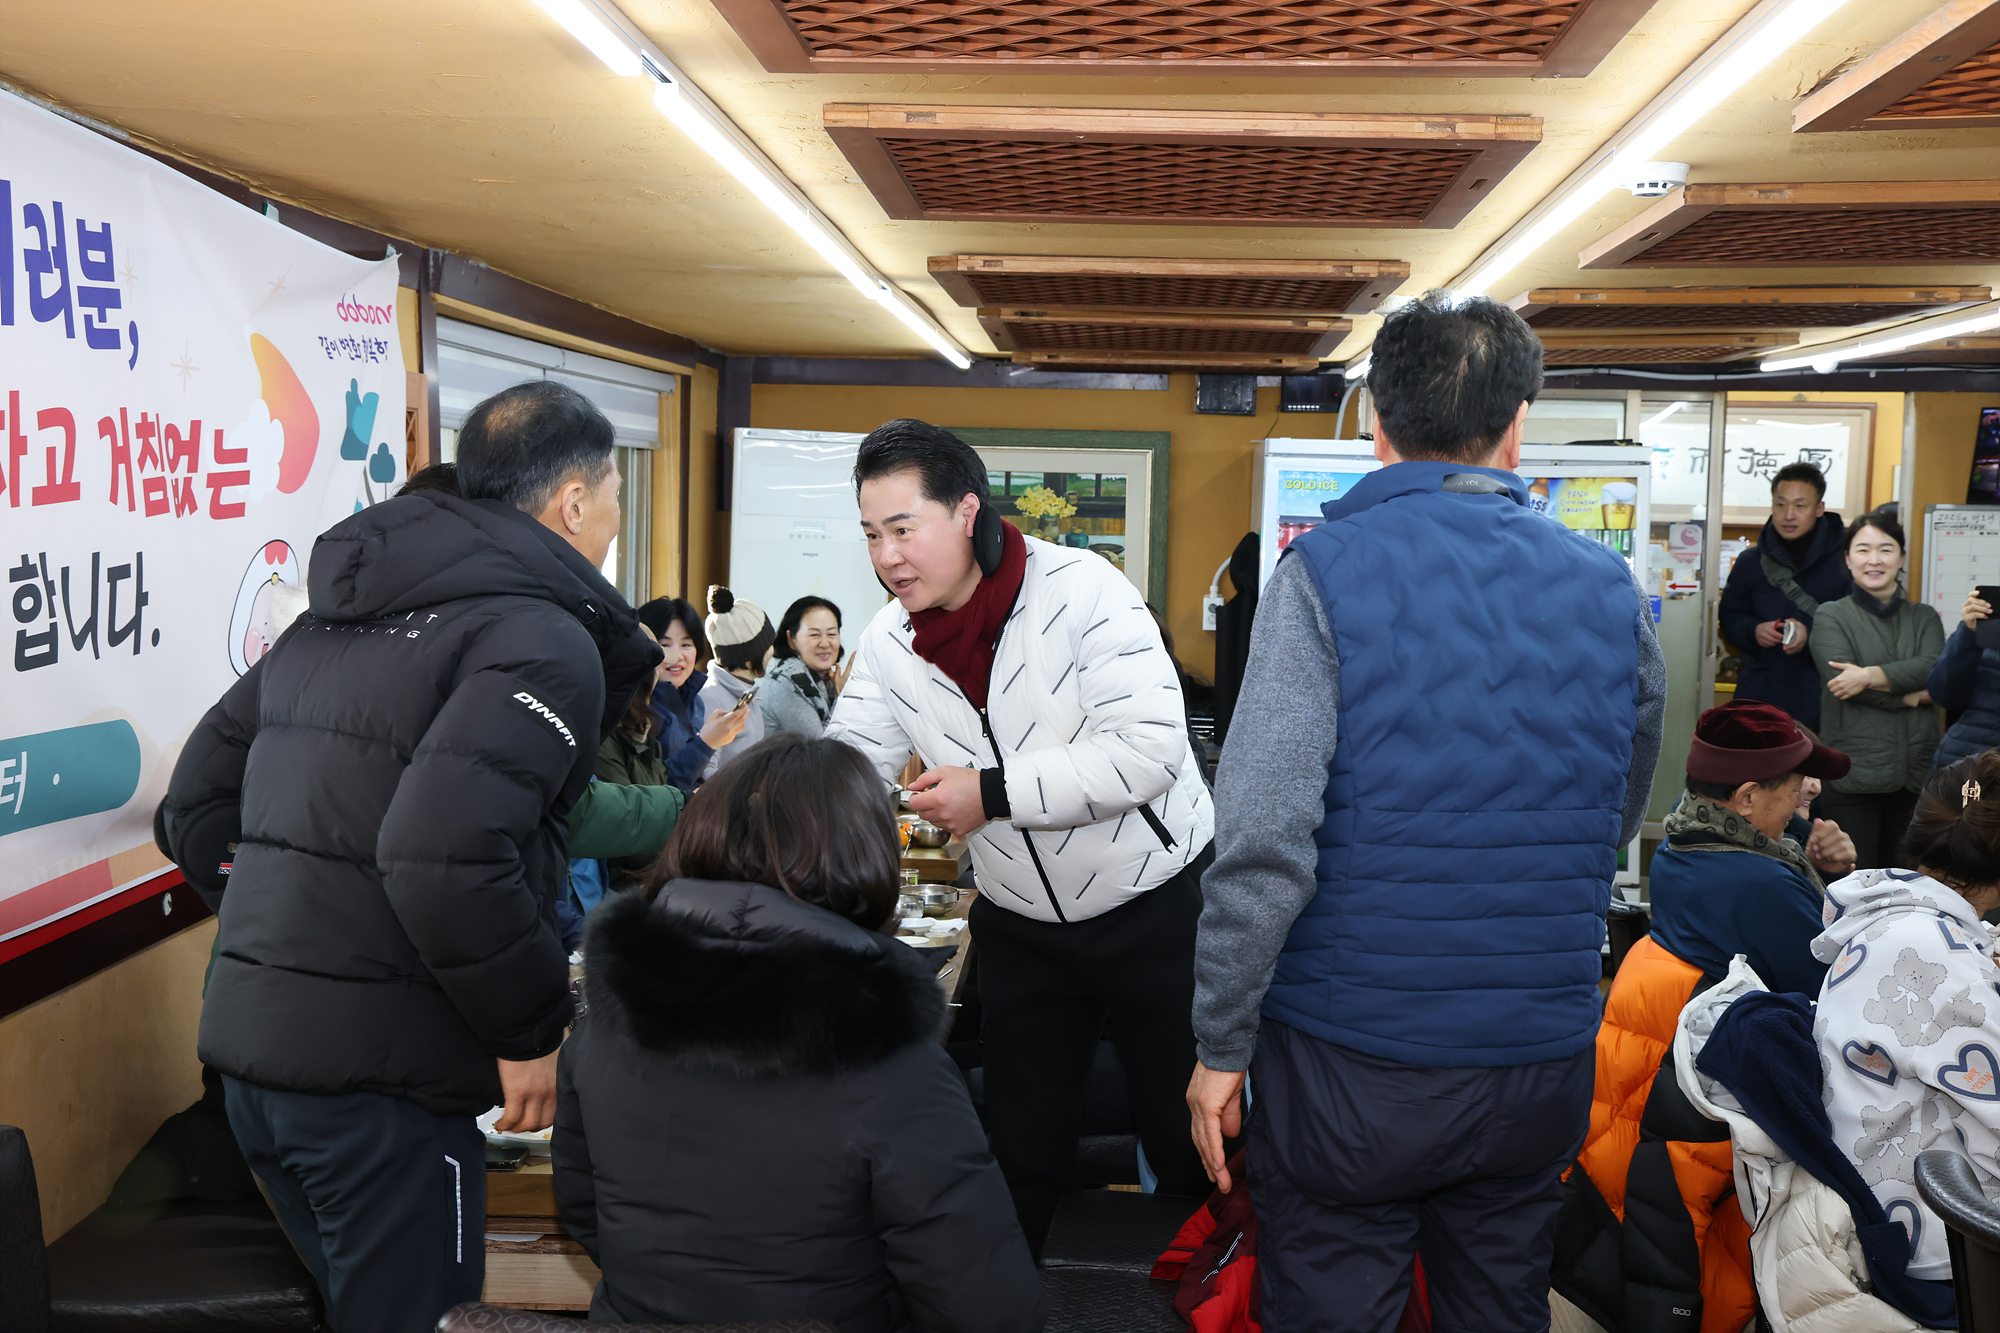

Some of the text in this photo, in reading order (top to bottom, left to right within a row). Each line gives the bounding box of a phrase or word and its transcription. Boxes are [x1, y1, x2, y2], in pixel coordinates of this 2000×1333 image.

[318, 336, 341, 360] 같이
[97, 406, 251, 520] 거침없는
[1284, 479, 1339, 491] GOLD ICE
[1529, 499, 1547, 512] ASS
[9, 551, 160, 672] 합니다.
[512, 691, 576, 747] DYNAFIT
[1970, 1072, 1995, 1093] MORIN
